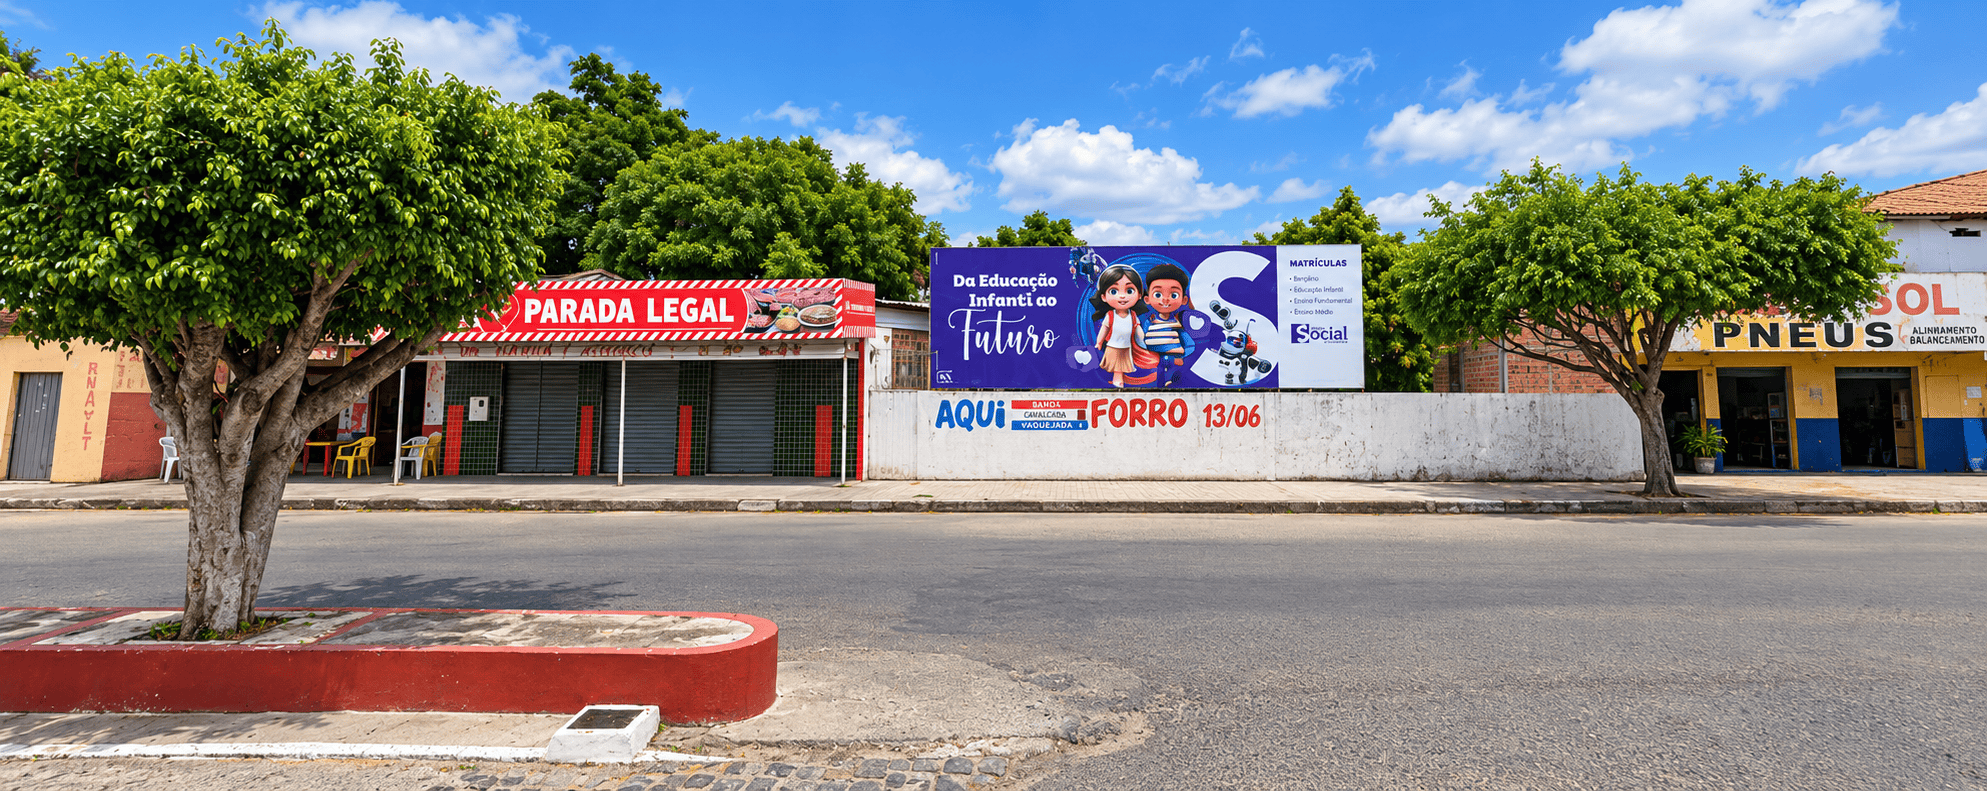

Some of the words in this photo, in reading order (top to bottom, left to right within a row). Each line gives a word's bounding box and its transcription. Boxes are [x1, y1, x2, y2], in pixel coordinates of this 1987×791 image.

[1289, 257, 1347, 267] MATRÍCULAS
[953, 274, 976, 287] Da
[979, 273, 1058, 292] Educação
[968, 293, 1033, 307] Infanti
[1036, 296, 1058, 307] ao
[524, 298, 636, 324] PARADA
[646, 297, 735, 324] LEGAL
[948, 308, 1060, 361] Futuro
[1296, 325, 1348, 343] Social
[1713, 321, 1895, 348] PNEUS
[1912, 326, 1977, 336] ALINHAMENTO
[1909, 335, 1986, 346] BALANCEAMENTO
[1091, 398, 1189, 428] FORRO
[1202, 403, 1261, 428] 13/06
